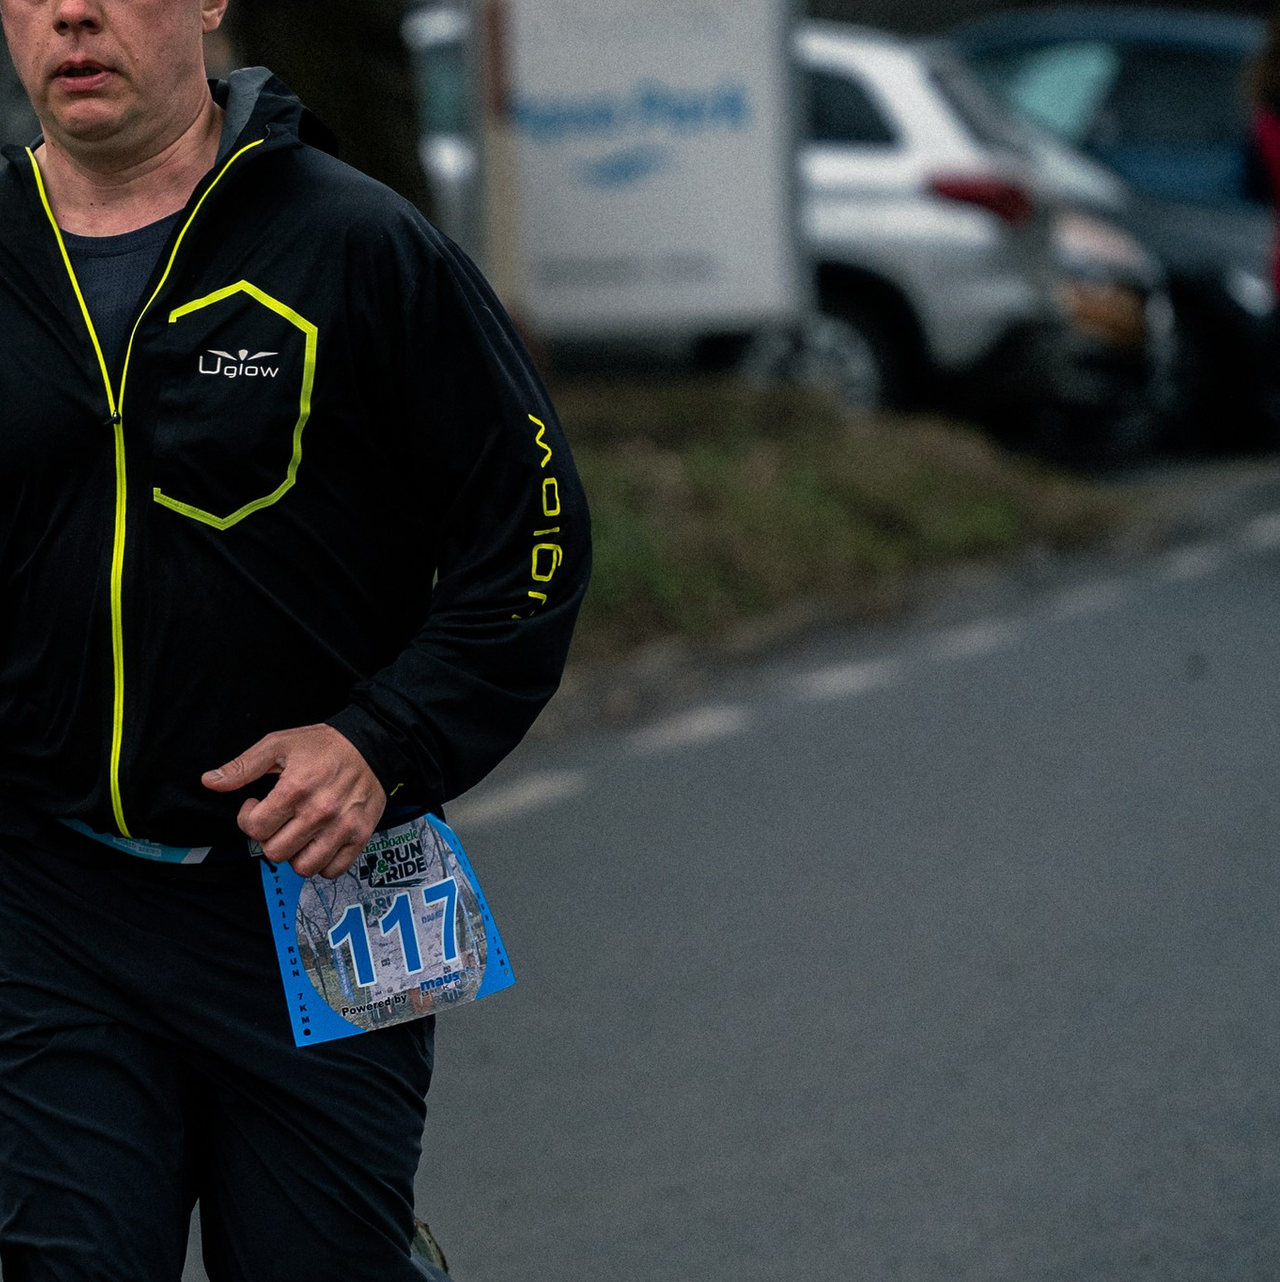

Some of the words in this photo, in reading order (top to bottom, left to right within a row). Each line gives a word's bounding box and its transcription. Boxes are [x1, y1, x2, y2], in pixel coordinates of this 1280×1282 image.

[198, 355, 279, 379] Uglow
[381, 840, 424, 865] RUN
[376, 859, 389, 874] &
[386, 857, 428, 883] RIDE
[328, 876, 458, 988] 117
[274, 875, 290, 931] TRAIL
[287, 945, 300, 978] RUN
[297, 992, 311, 1024] 7KM
[420, 970, 460, 992] maus
[341, 996, 391, 1017] Powered
[394, 993, 407, 1005] by
